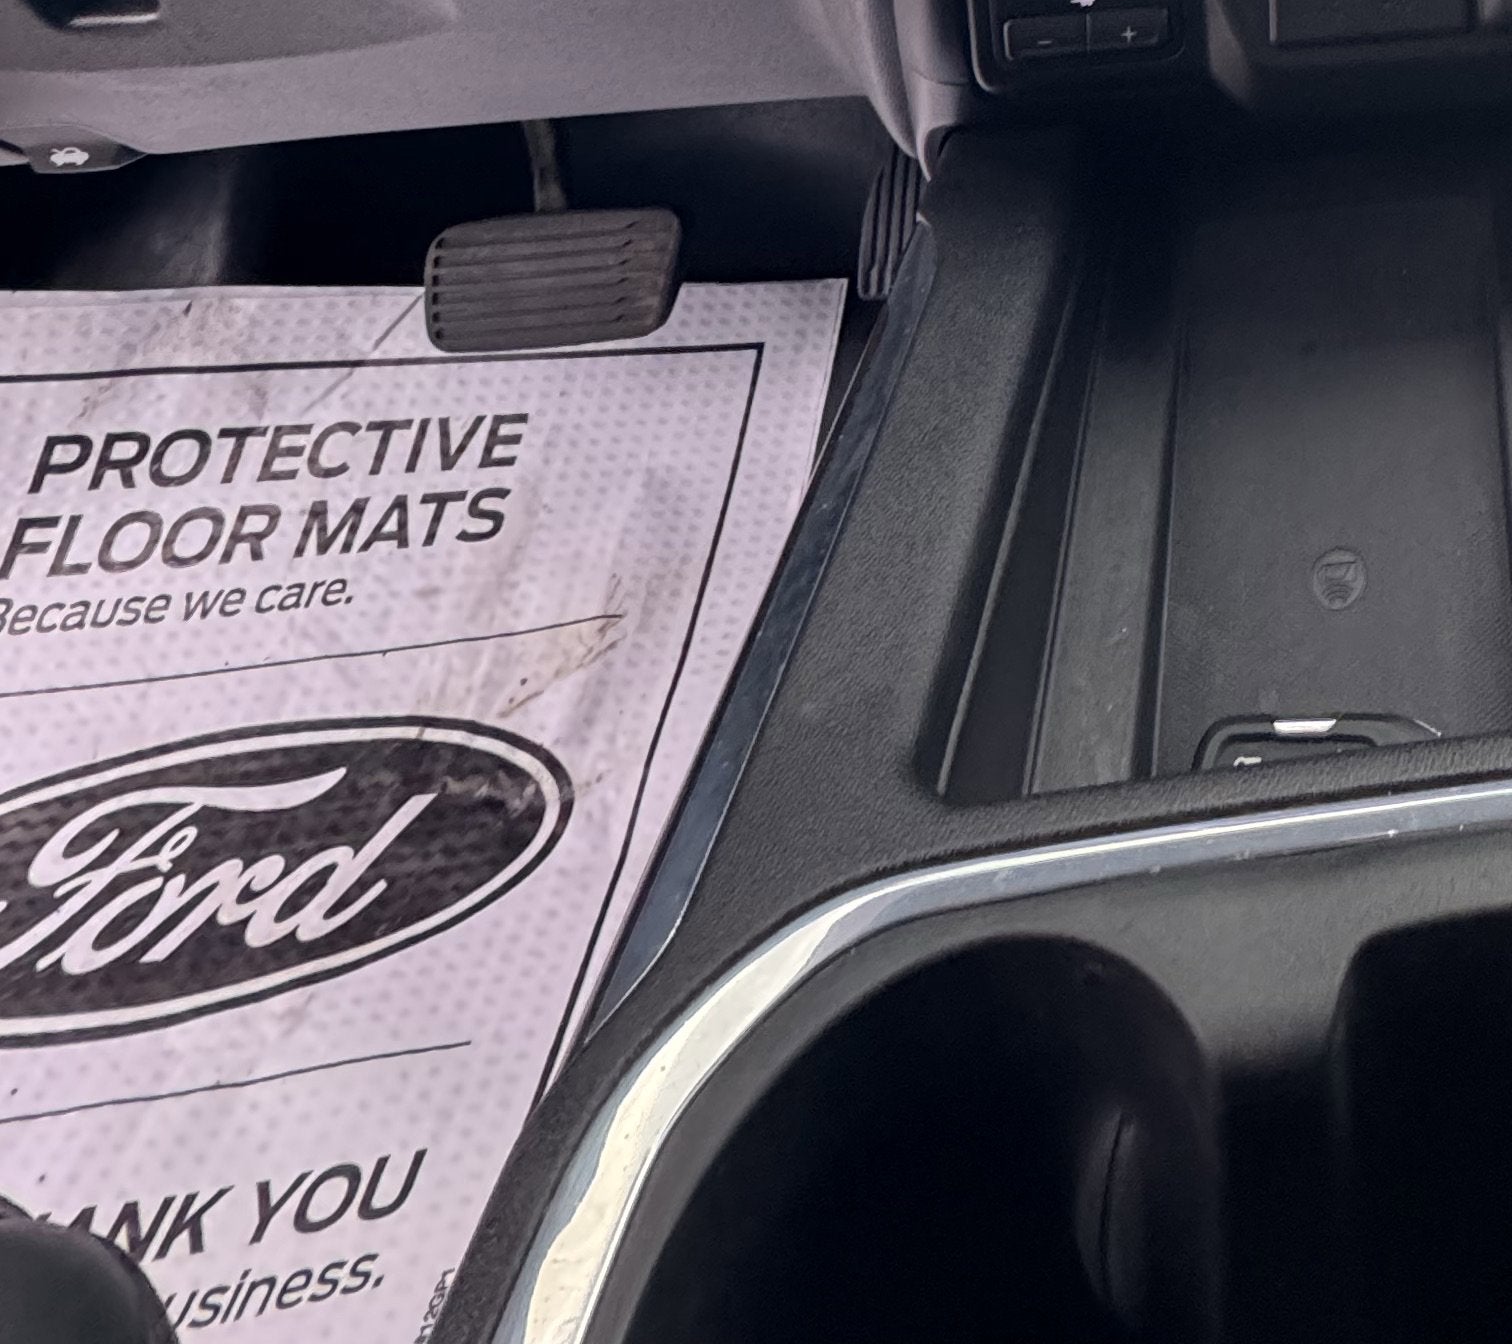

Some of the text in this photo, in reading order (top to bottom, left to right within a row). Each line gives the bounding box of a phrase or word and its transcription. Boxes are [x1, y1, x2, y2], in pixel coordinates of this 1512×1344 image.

[27, 412, 530, 495] PROTECTIVE
[0, 486, 512, 581] FLOOR MATS
[183, 586, 247, 621] we
[254, 577, 355, 614] care.
[0, 767, 440, 976] Ford
[249, 1148, 428, 1246] YOU
[163, 1253, 386, 1329] usiness.
